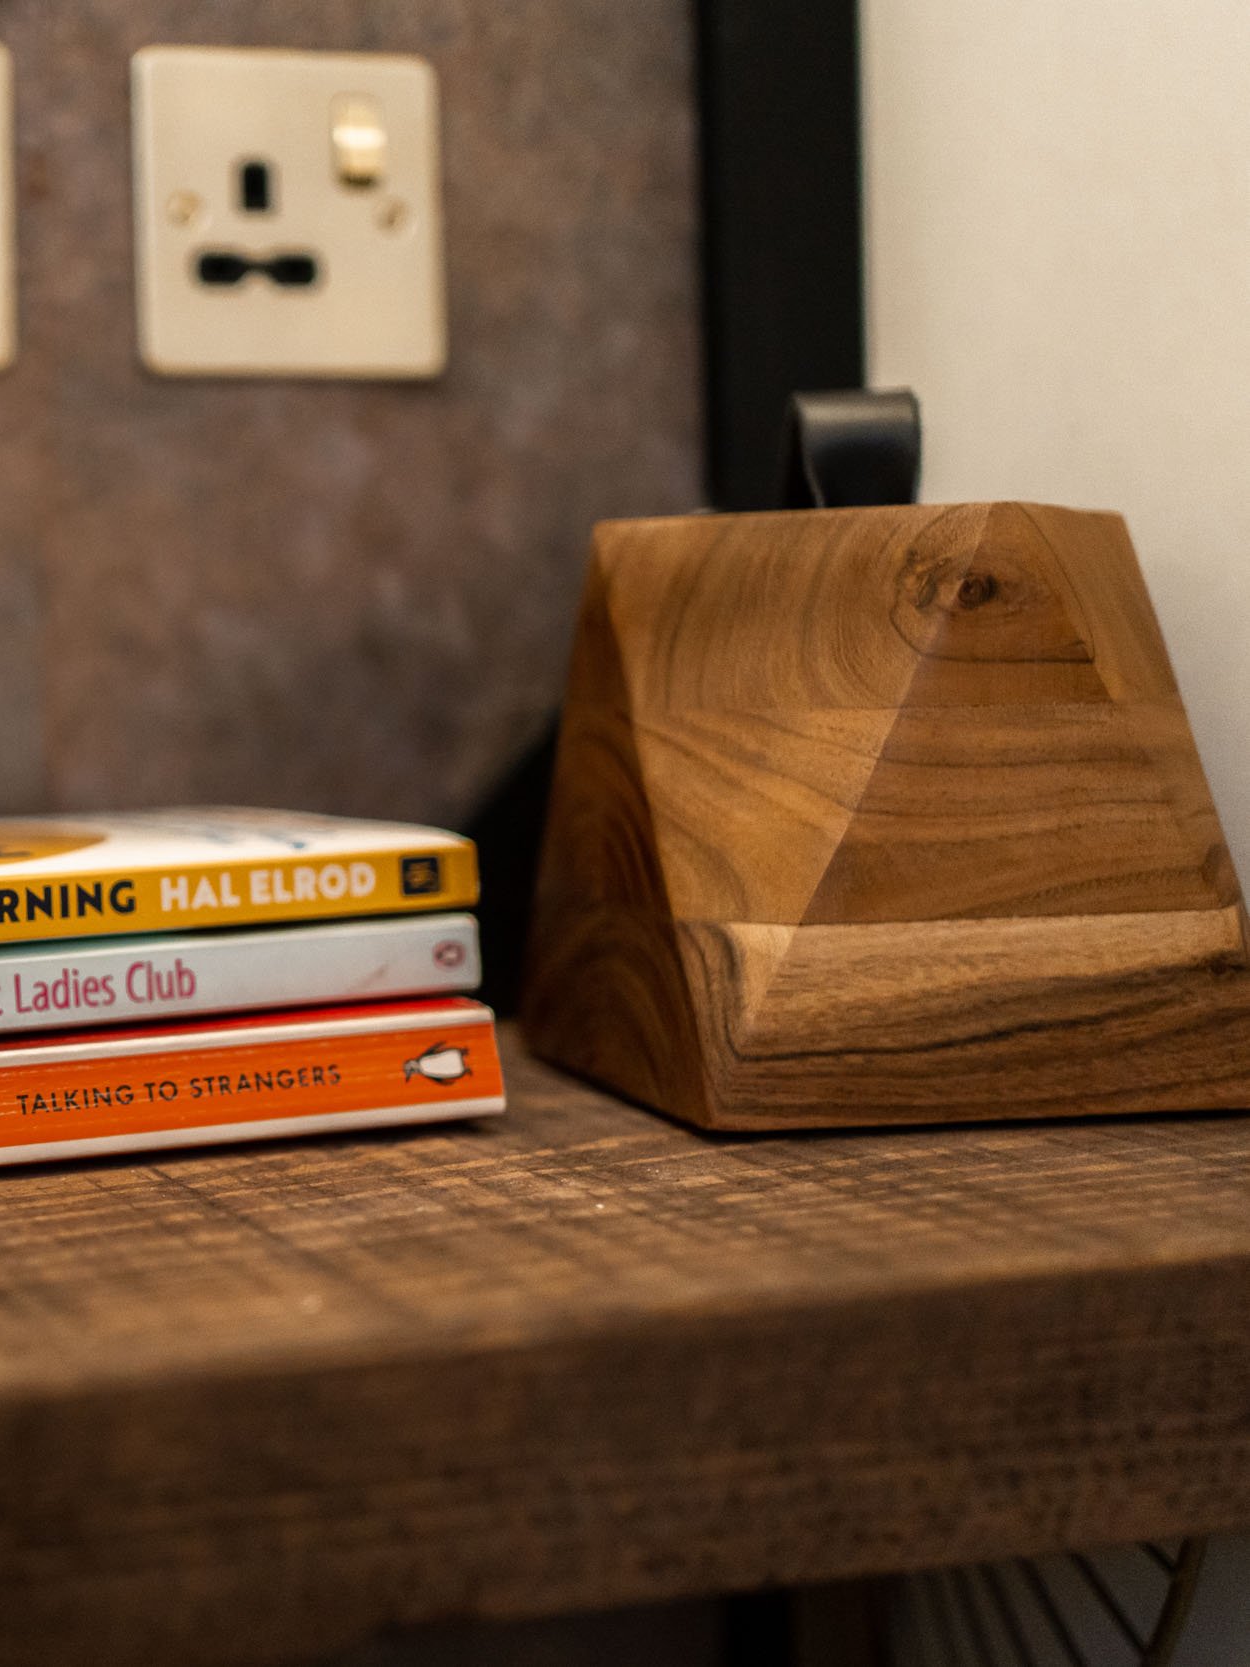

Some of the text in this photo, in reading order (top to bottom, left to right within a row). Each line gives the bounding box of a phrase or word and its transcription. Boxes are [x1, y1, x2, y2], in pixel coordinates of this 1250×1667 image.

[160, 872, 241, 912] HAL
[250, 862, 376, 903] ELROD
[14, 967, 116, 1014] Ladies
[126, 958, 197, 1003] Club
[16, 1084, 135, 1116] TALKING
[144, 1081, 179, 1103] TO
[190, 1064, 342, 1098] STRANGERS
